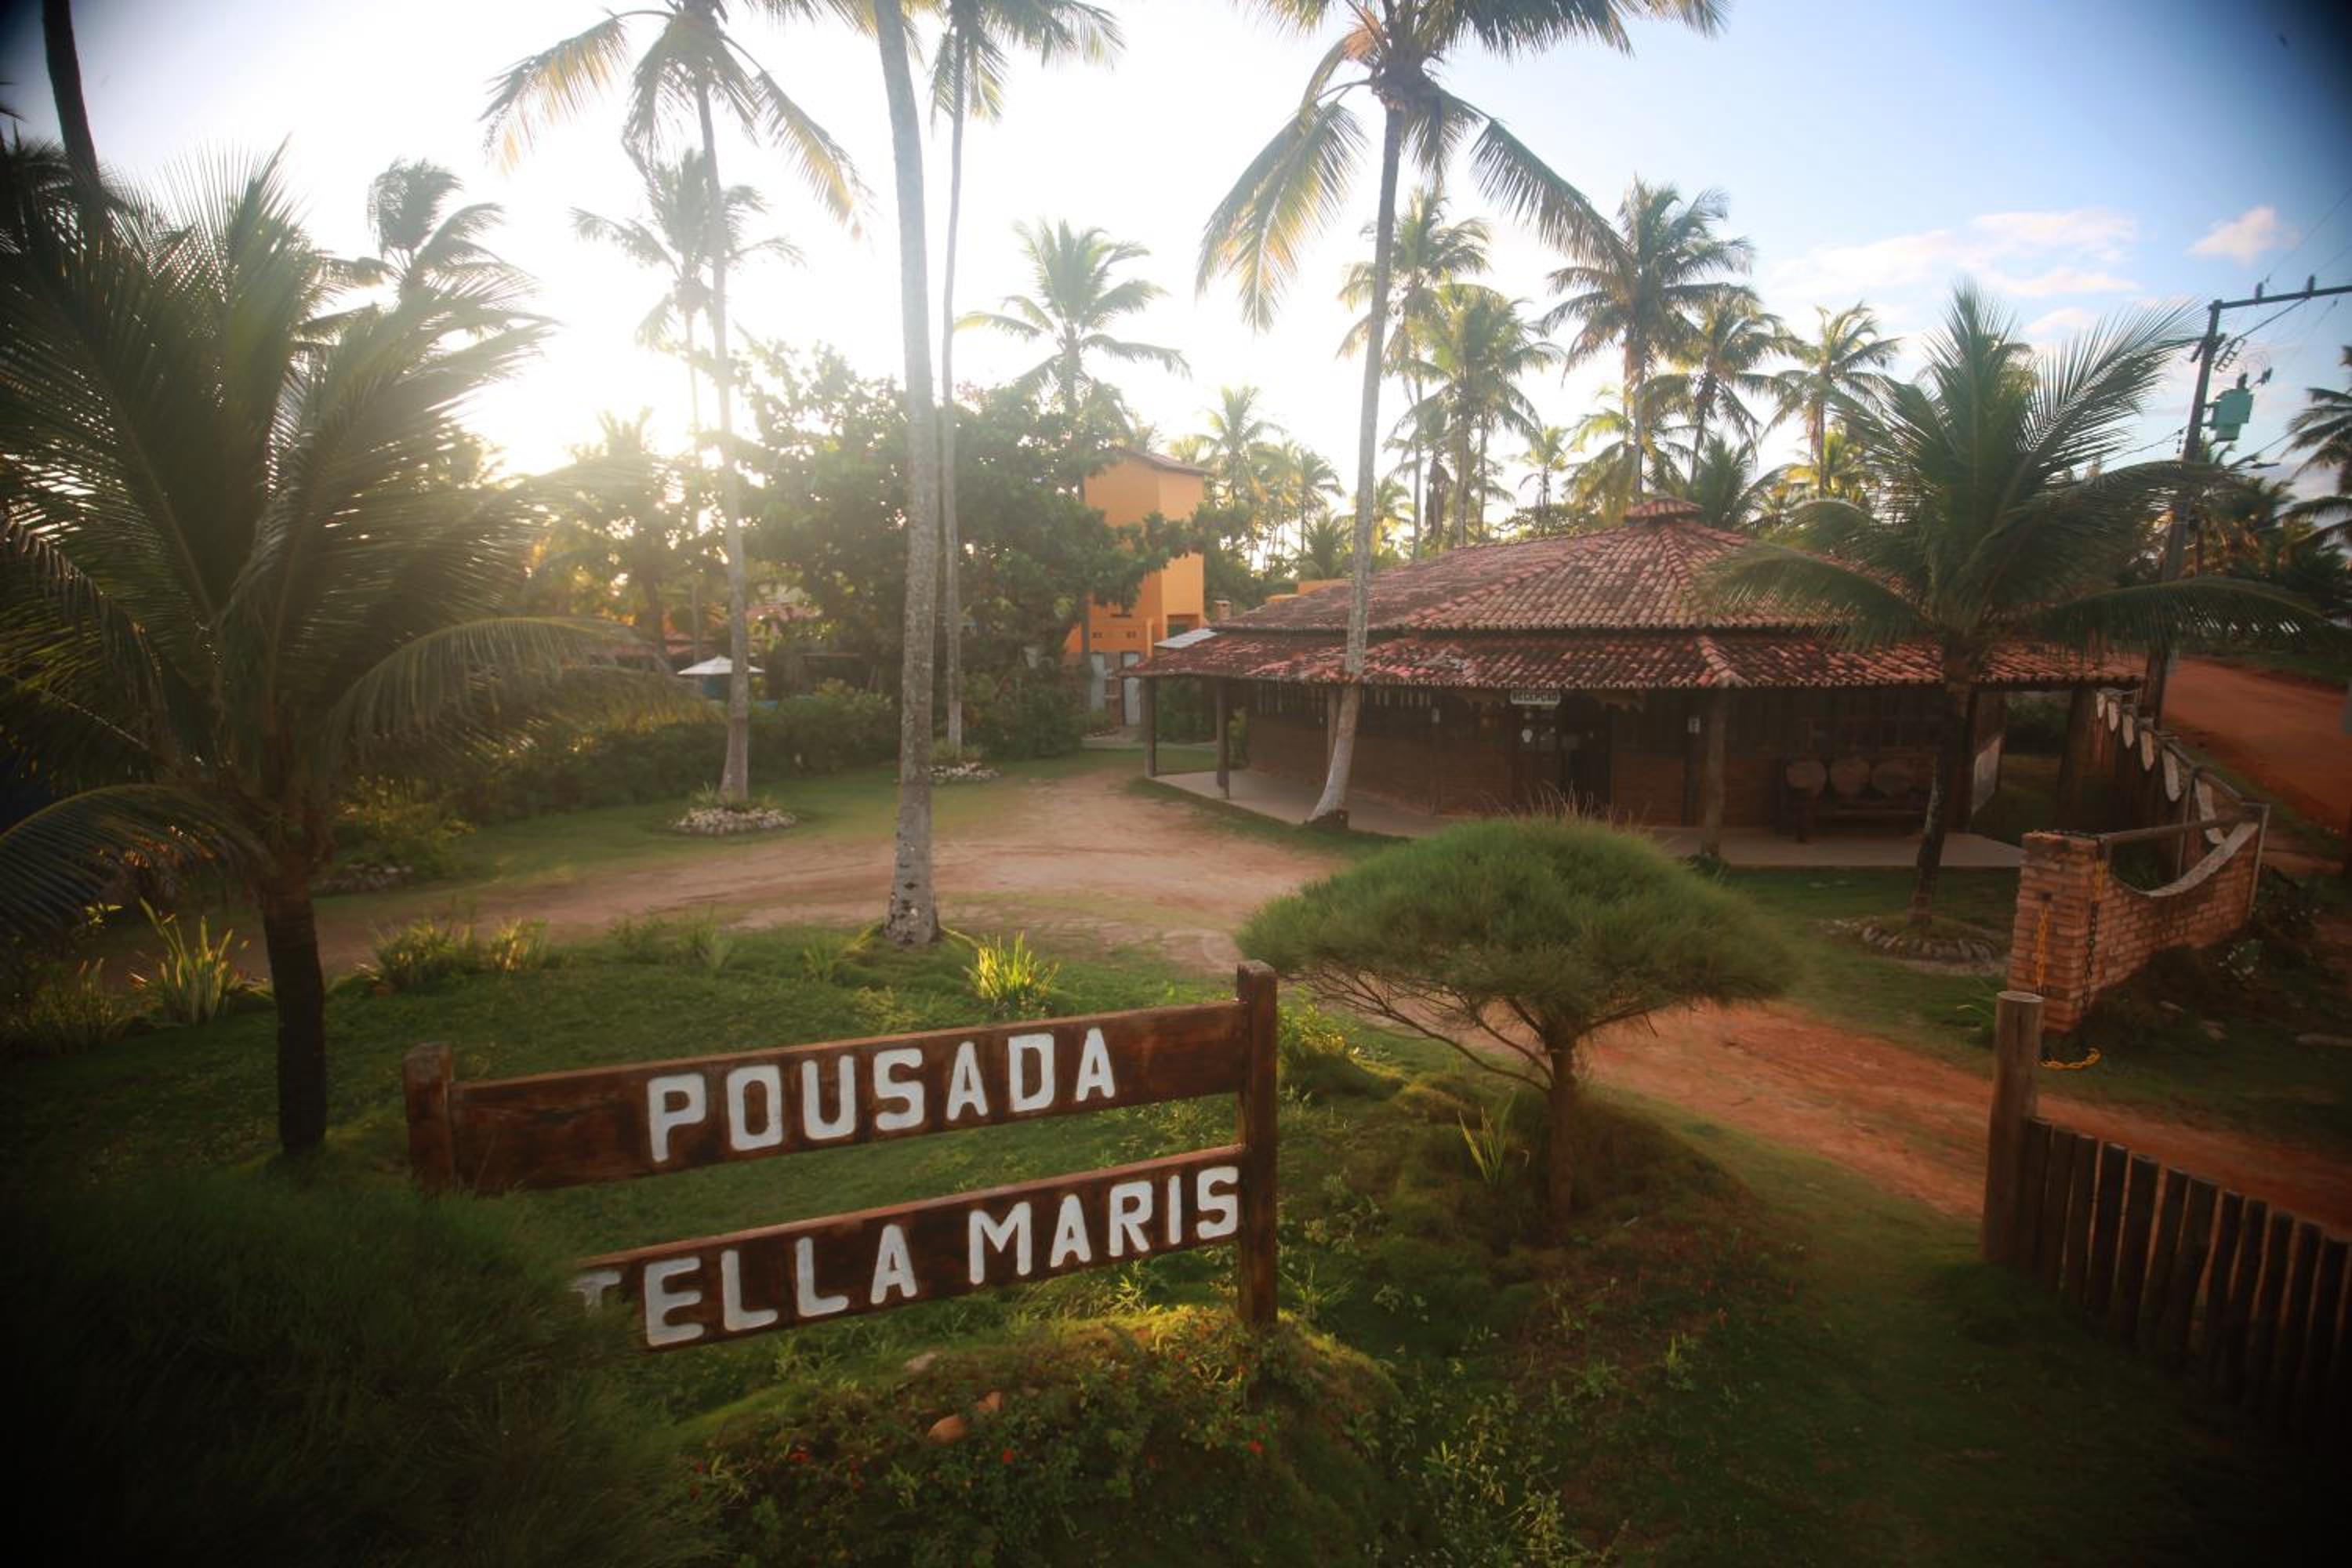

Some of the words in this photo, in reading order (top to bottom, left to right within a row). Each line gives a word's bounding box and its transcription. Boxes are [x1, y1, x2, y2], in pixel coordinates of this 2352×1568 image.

[646, 1027, 1116, 1163] POUSADA
[571, 1223, 918, 1347] TELLA
[967, 1166, 1240, 1285] MARIS
